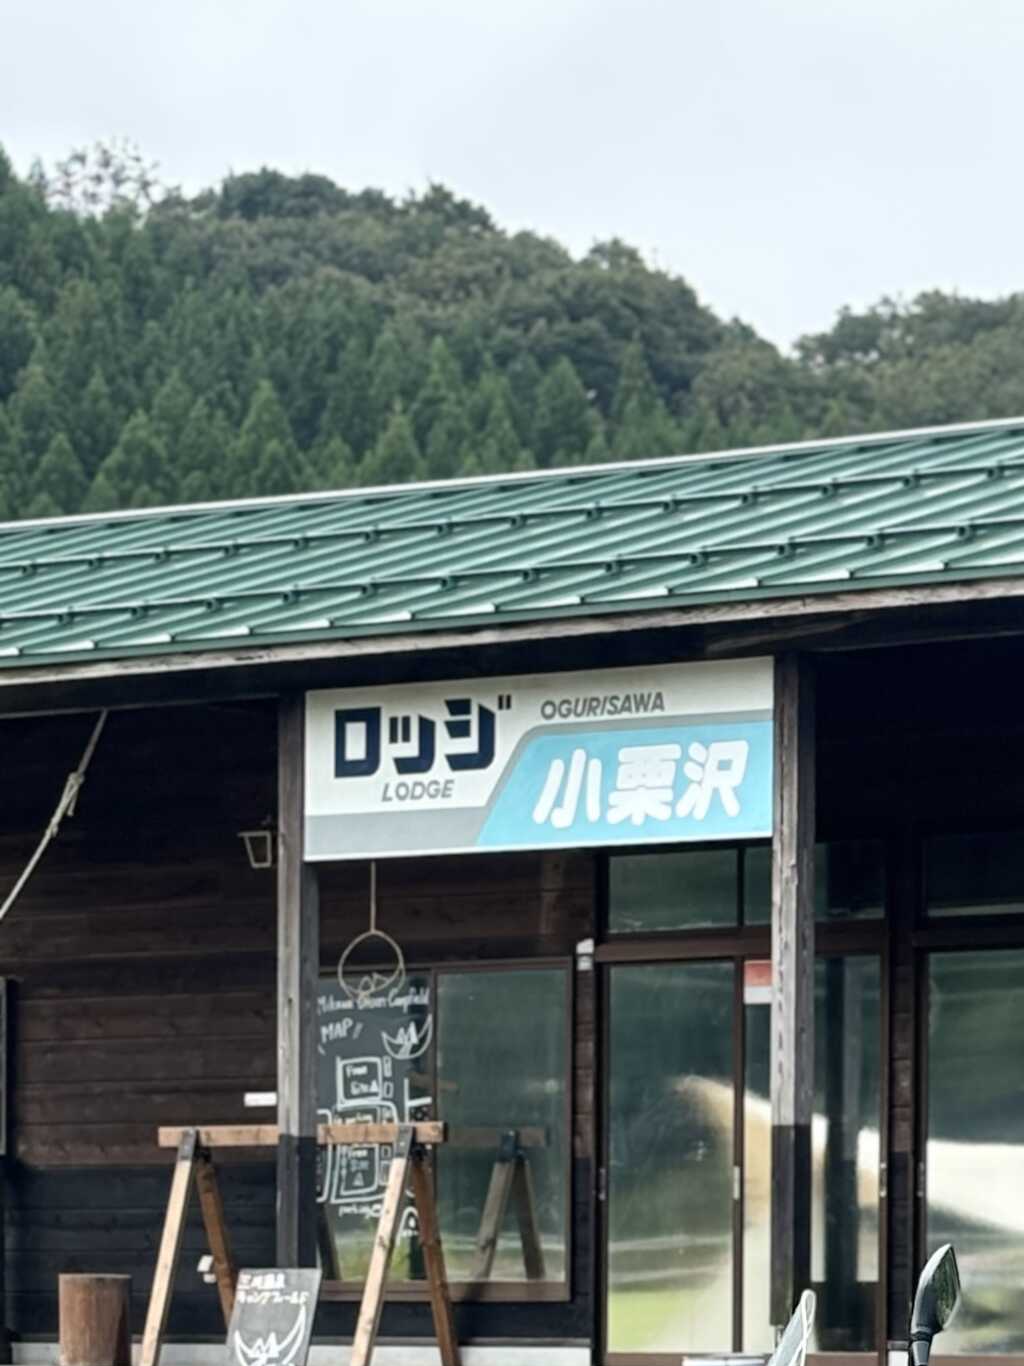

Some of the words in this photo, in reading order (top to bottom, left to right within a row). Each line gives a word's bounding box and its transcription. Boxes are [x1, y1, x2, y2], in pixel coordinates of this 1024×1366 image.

[540, 692, 665, 720] OGURISAWA
[334, 694, 512, 779] ロッジ
[381, 779, 455, 802] LODGE
[532, 740, 749, 829] 小栗沢
